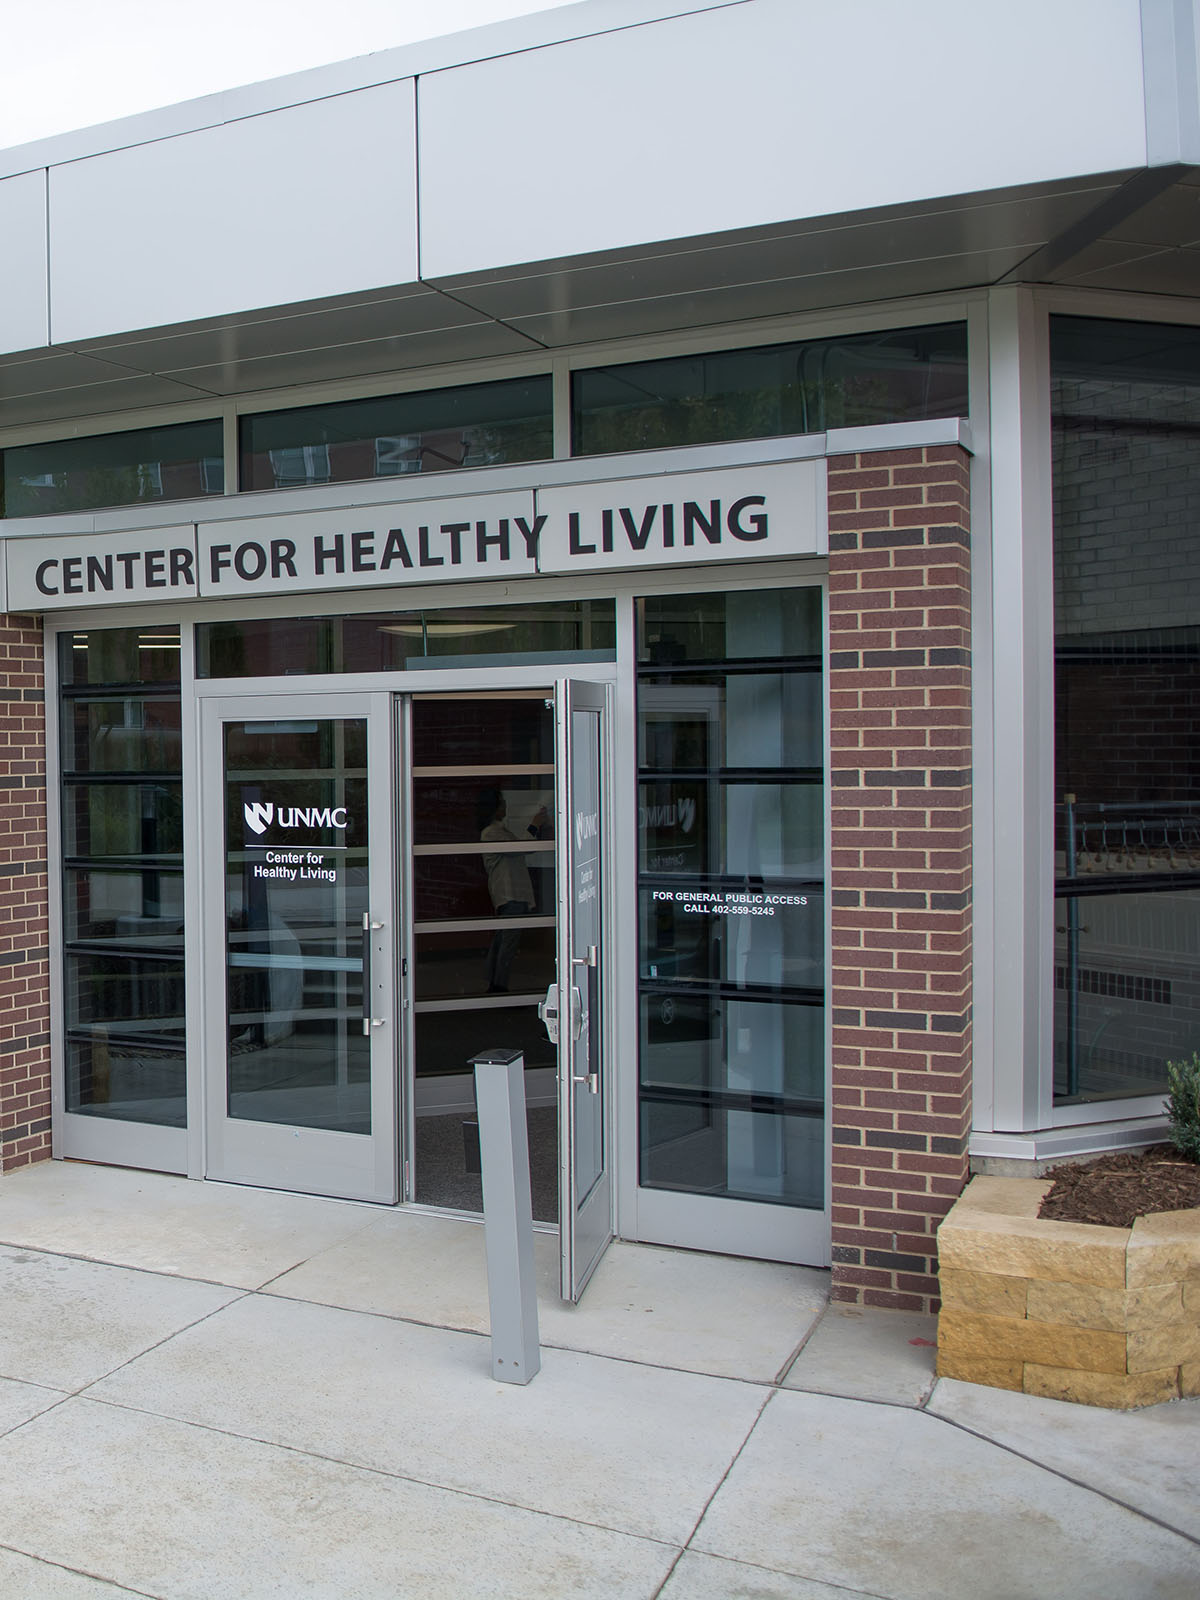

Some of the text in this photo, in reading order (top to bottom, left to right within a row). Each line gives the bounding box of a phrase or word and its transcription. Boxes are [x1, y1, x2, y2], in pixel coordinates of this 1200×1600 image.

[35, 495, 769, 596] CENTER FOR HEALTHY LIVING
[277, 807, 348, 829] UNMC
[265, 851, 324, 864] Center for
[254, 865, 337, 882] Healthy Living
[652, 891, 808, 905] FOR GENERAL PUBLIC ACCESS
[683, 904, 775, 916] CALL 402-559-5245
